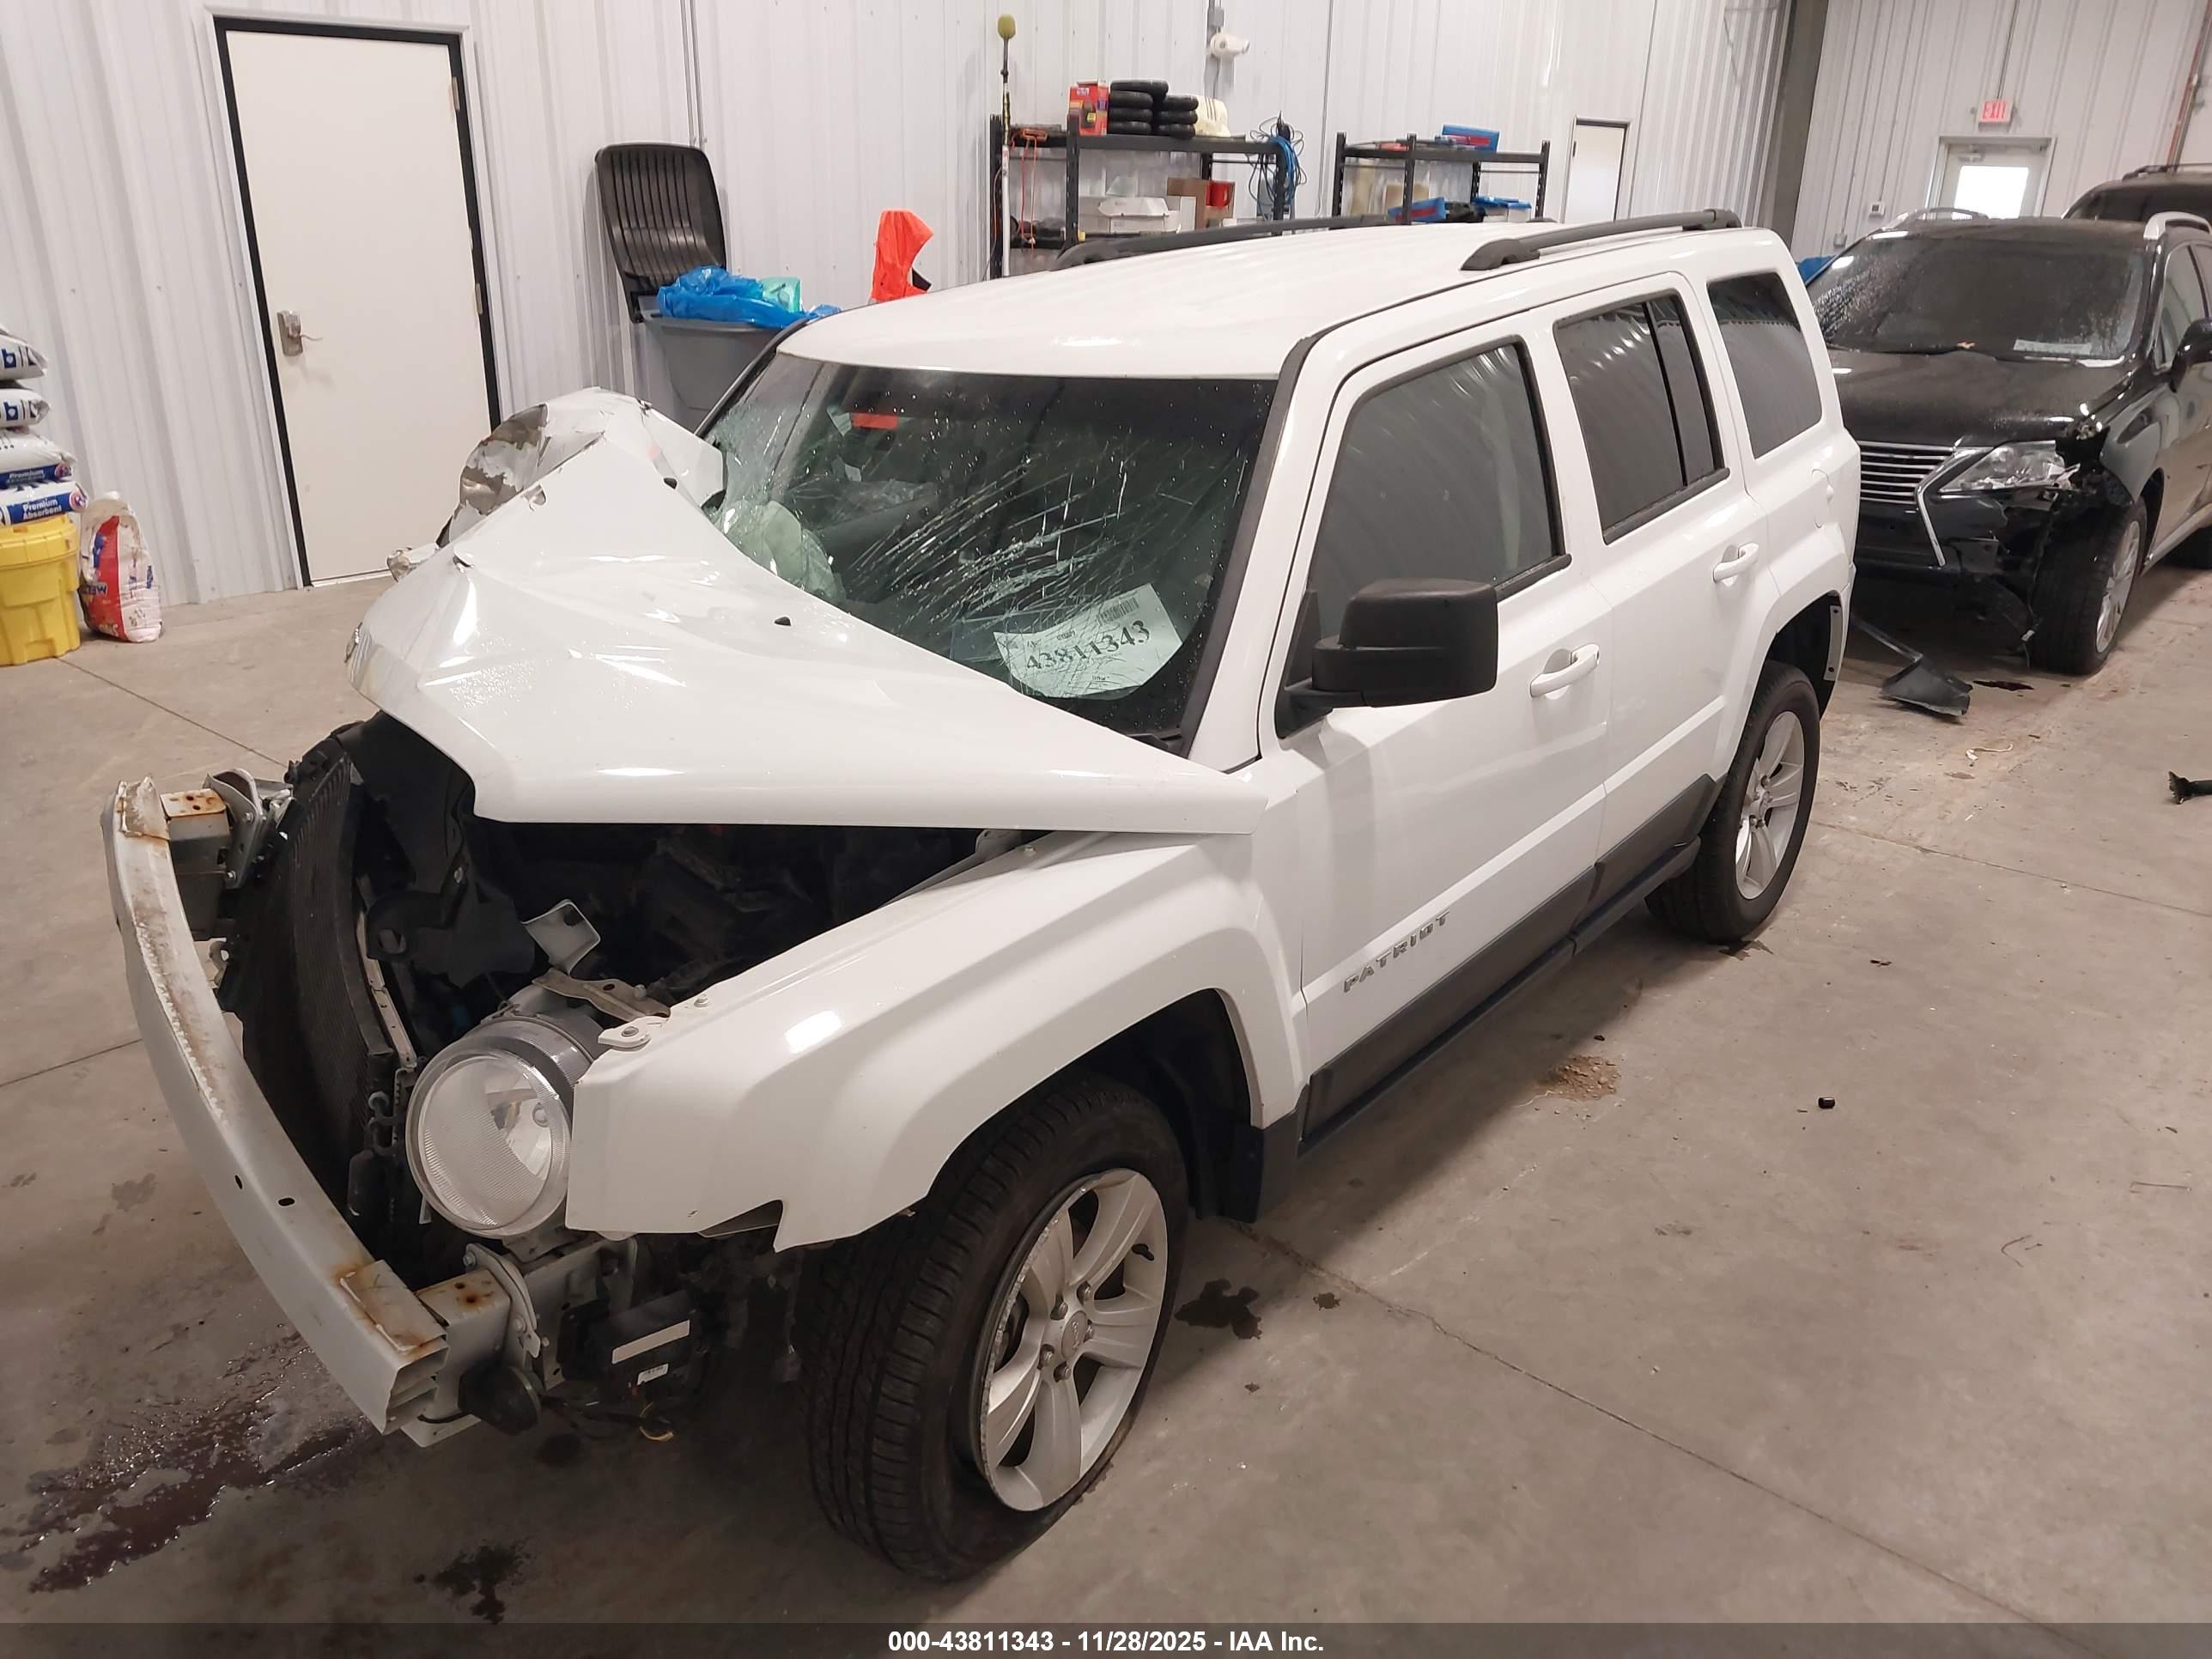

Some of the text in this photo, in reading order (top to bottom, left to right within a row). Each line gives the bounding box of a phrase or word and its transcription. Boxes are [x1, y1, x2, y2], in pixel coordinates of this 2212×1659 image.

[1982, 101, 2007, 118] EXIT
[22, 498, 58, 510] Premium
[1026, 620, 1150, 670] 43811343
[1343, 908, 1450, 993] PATRIOT
